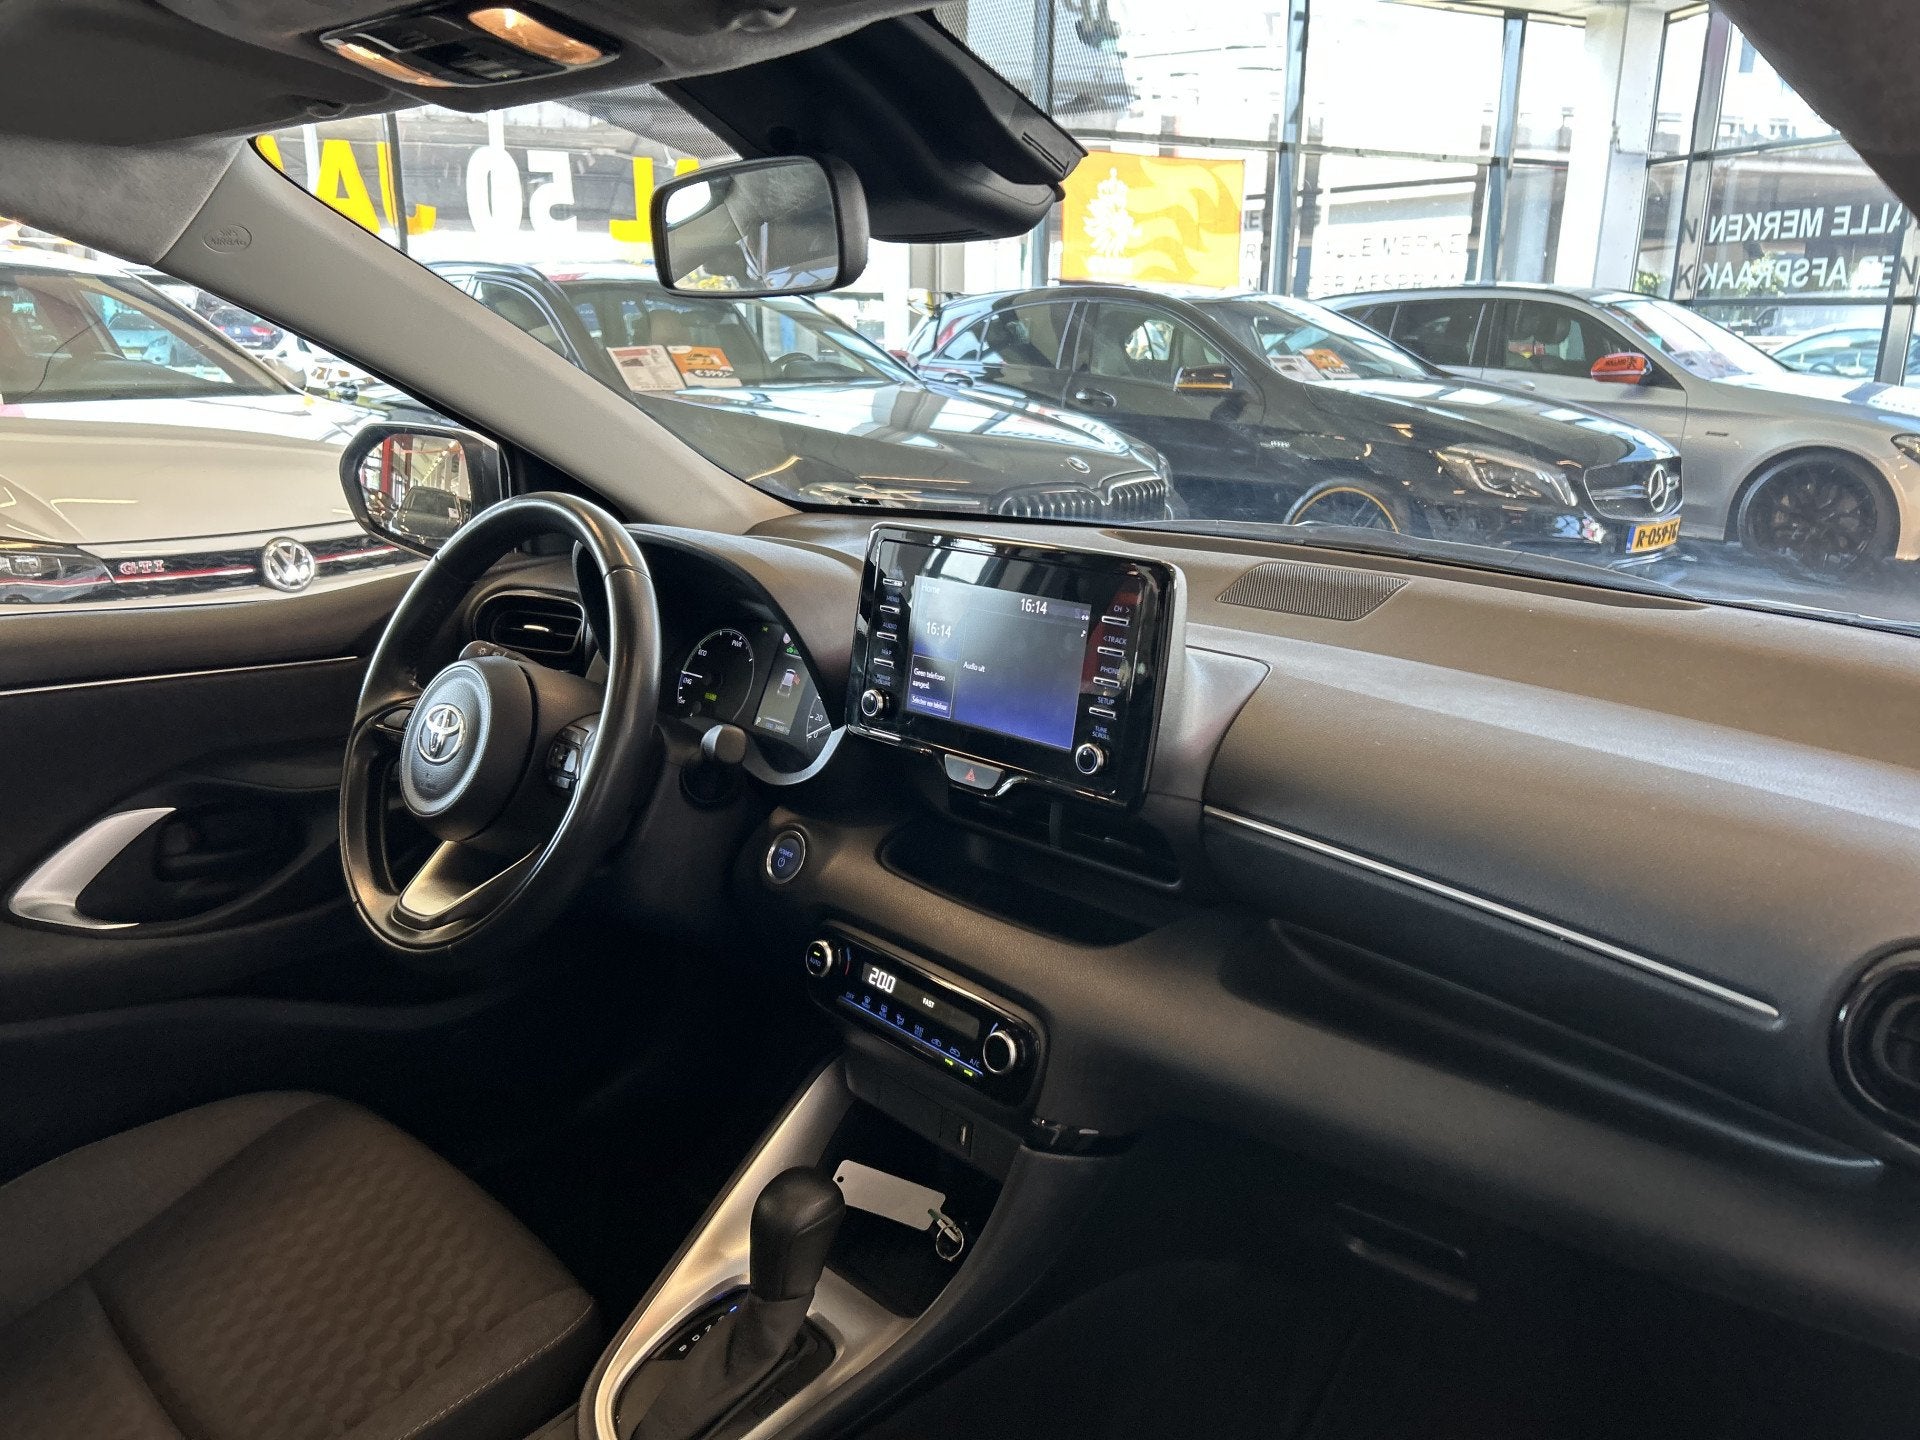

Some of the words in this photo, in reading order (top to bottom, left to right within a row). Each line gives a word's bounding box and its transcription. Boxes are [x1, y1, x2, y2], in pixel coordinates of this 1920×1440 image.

[119, 559, 165, 575] GTI
[1020, 598, 1048, 615] 16:14
[926, 621, 951, 639] 16:14
[963, 661, 978, 671] Audio
[1097, 697, 1115, 706] SETUP
[814, 713, 824, 722] 20
[922, 997, 935, 1009] FAST
